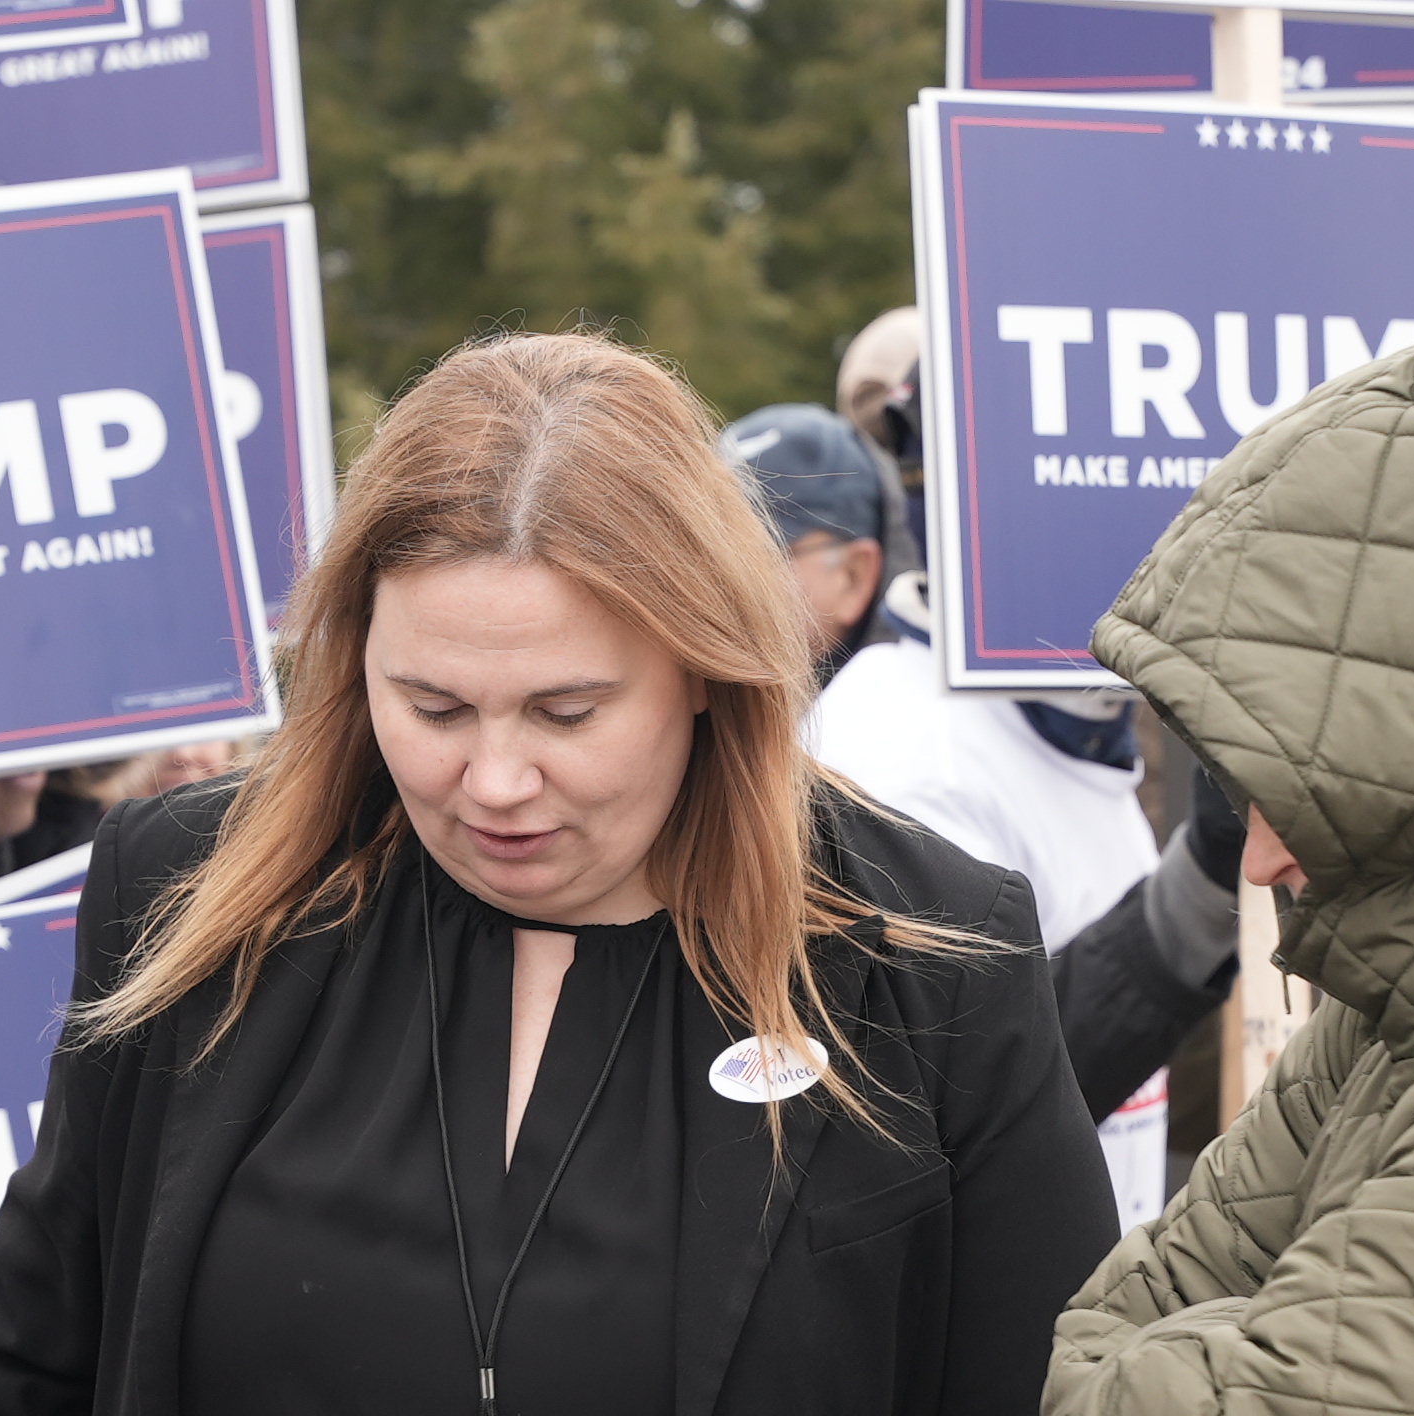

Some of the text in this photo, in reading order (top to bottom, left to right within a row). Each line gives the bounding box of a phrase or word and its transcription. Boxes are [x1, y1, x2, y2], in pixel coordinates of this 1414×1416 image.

[101, 32, 211, 73] AGAIN!
[1034, 454, 1129, 487] MAKE
[22, 526, 154, 574] AGAIN!
